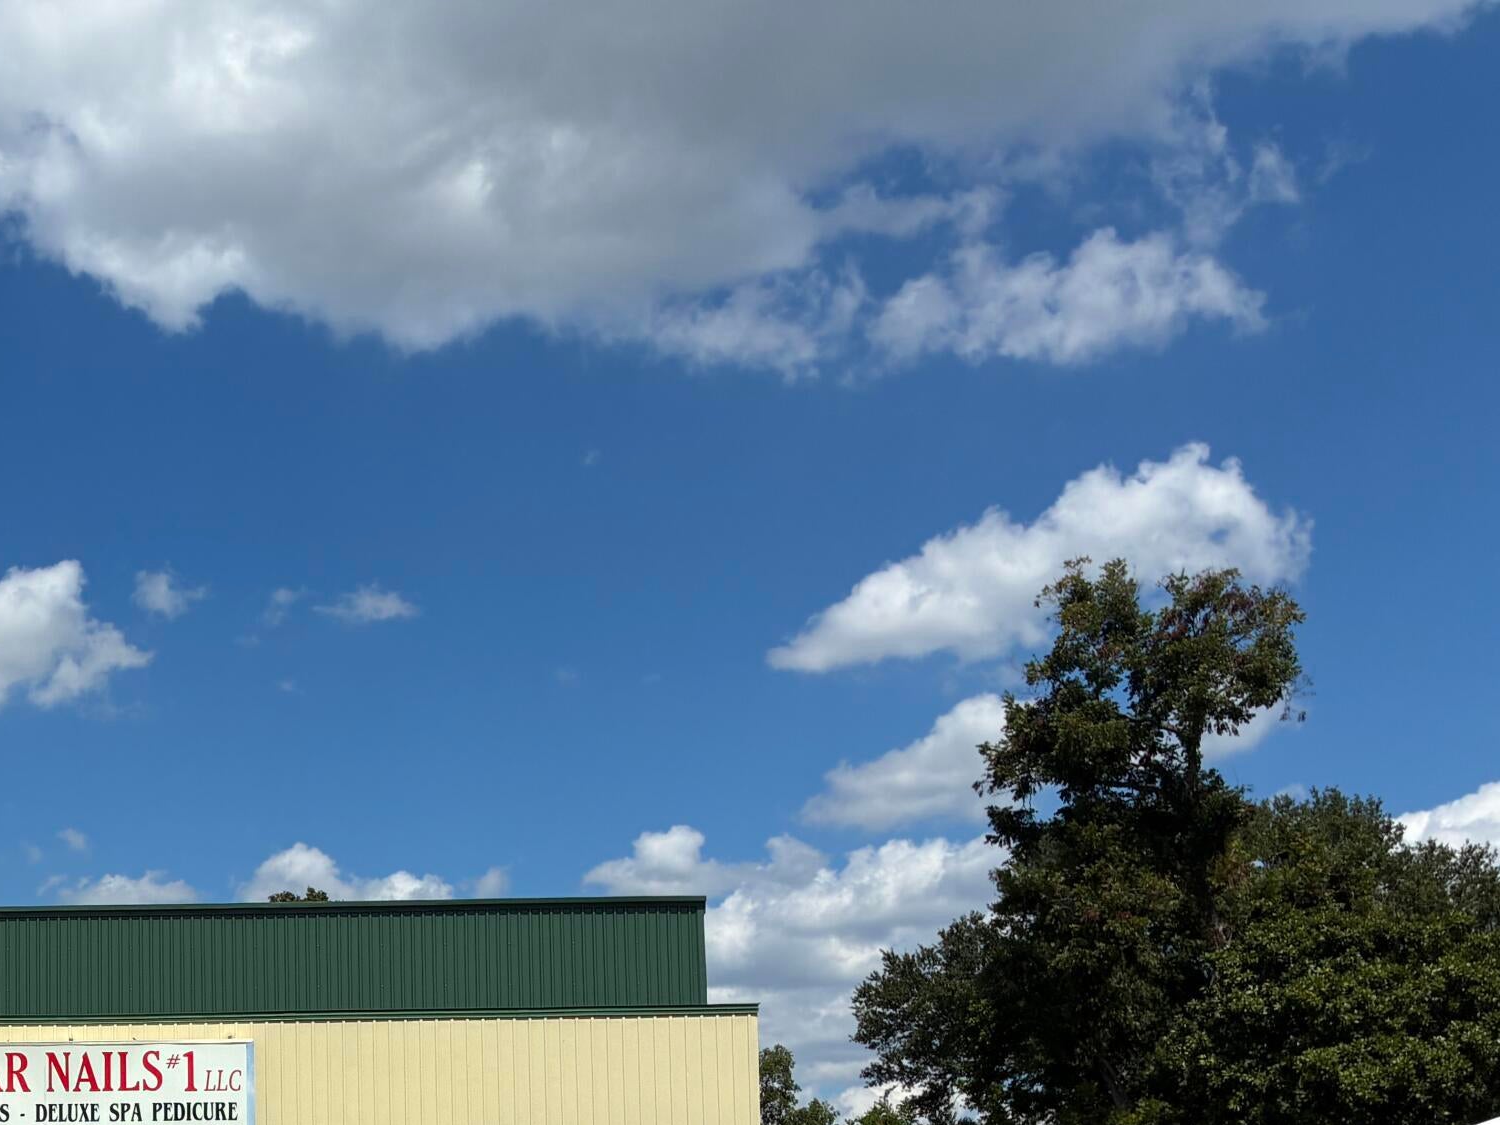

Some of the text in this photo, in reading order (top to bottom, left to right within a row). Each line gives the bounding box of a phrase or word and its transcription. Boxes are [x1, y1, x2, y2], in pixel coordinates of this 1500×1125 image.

[46, 1050, 164, 1093] NAILS
[203, 1069, 243, 1092] LLC
[35, 1104, 100, 1122] DELUXE
[109, 1103, 143, 1122] SPA
[152, 1102, 238, 1122] PEDICURE
